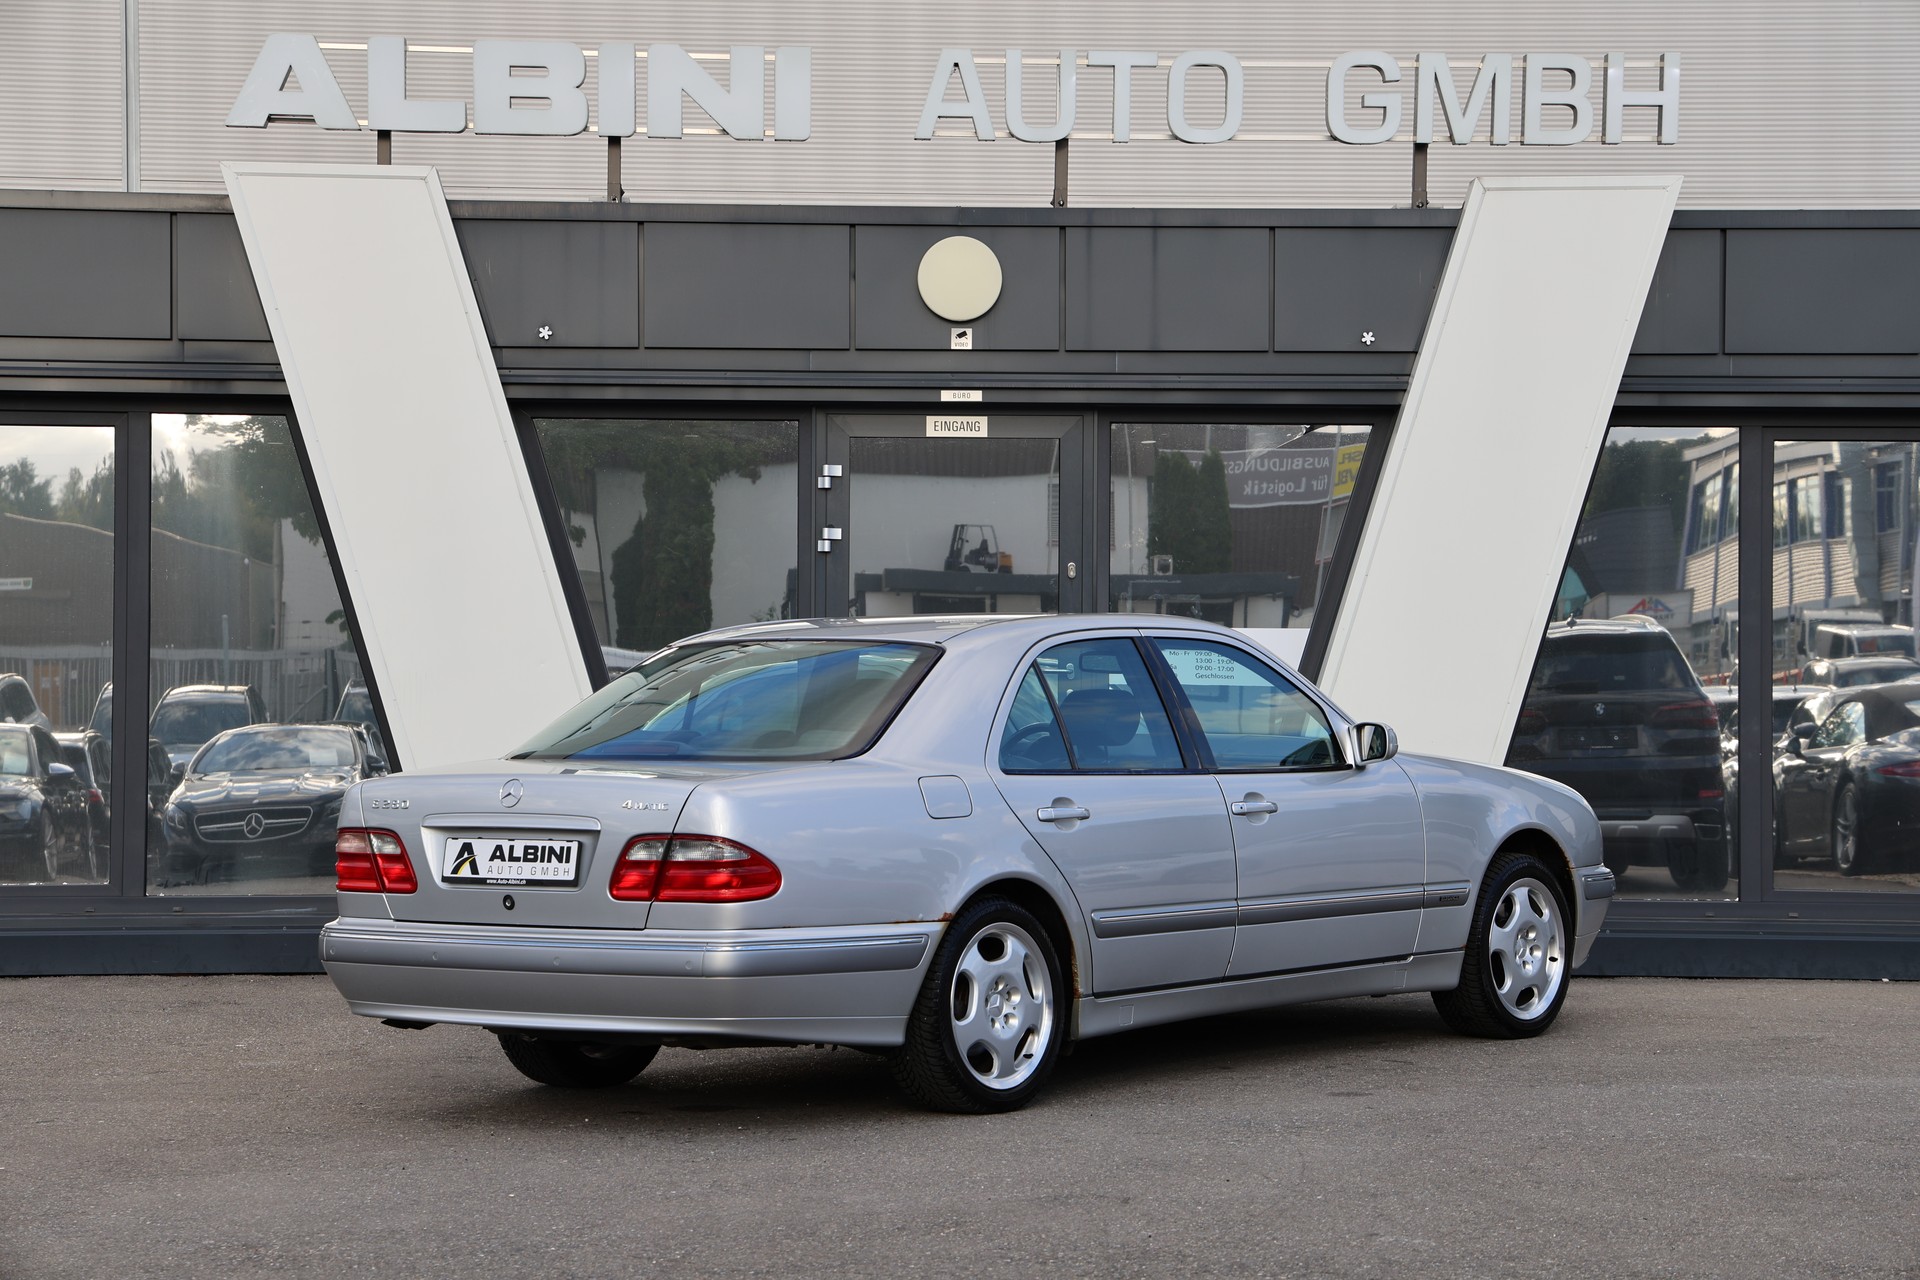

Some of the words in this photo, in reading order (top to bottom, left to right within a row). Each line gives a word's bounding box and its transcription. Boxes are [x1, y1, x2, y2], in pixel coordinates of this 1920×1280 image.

[225, 33, 811, 141] ALBINI
[914, 48, 1244, 144] AUTO
[1325, 51, 1681, 146] GMBH
[933, 420, 981, 433] EINGANG
[488, 844, 572, 864] ALBINI
[486, 865, 523, 875] AUTO
[530, 866, 570, 877] GMBH
